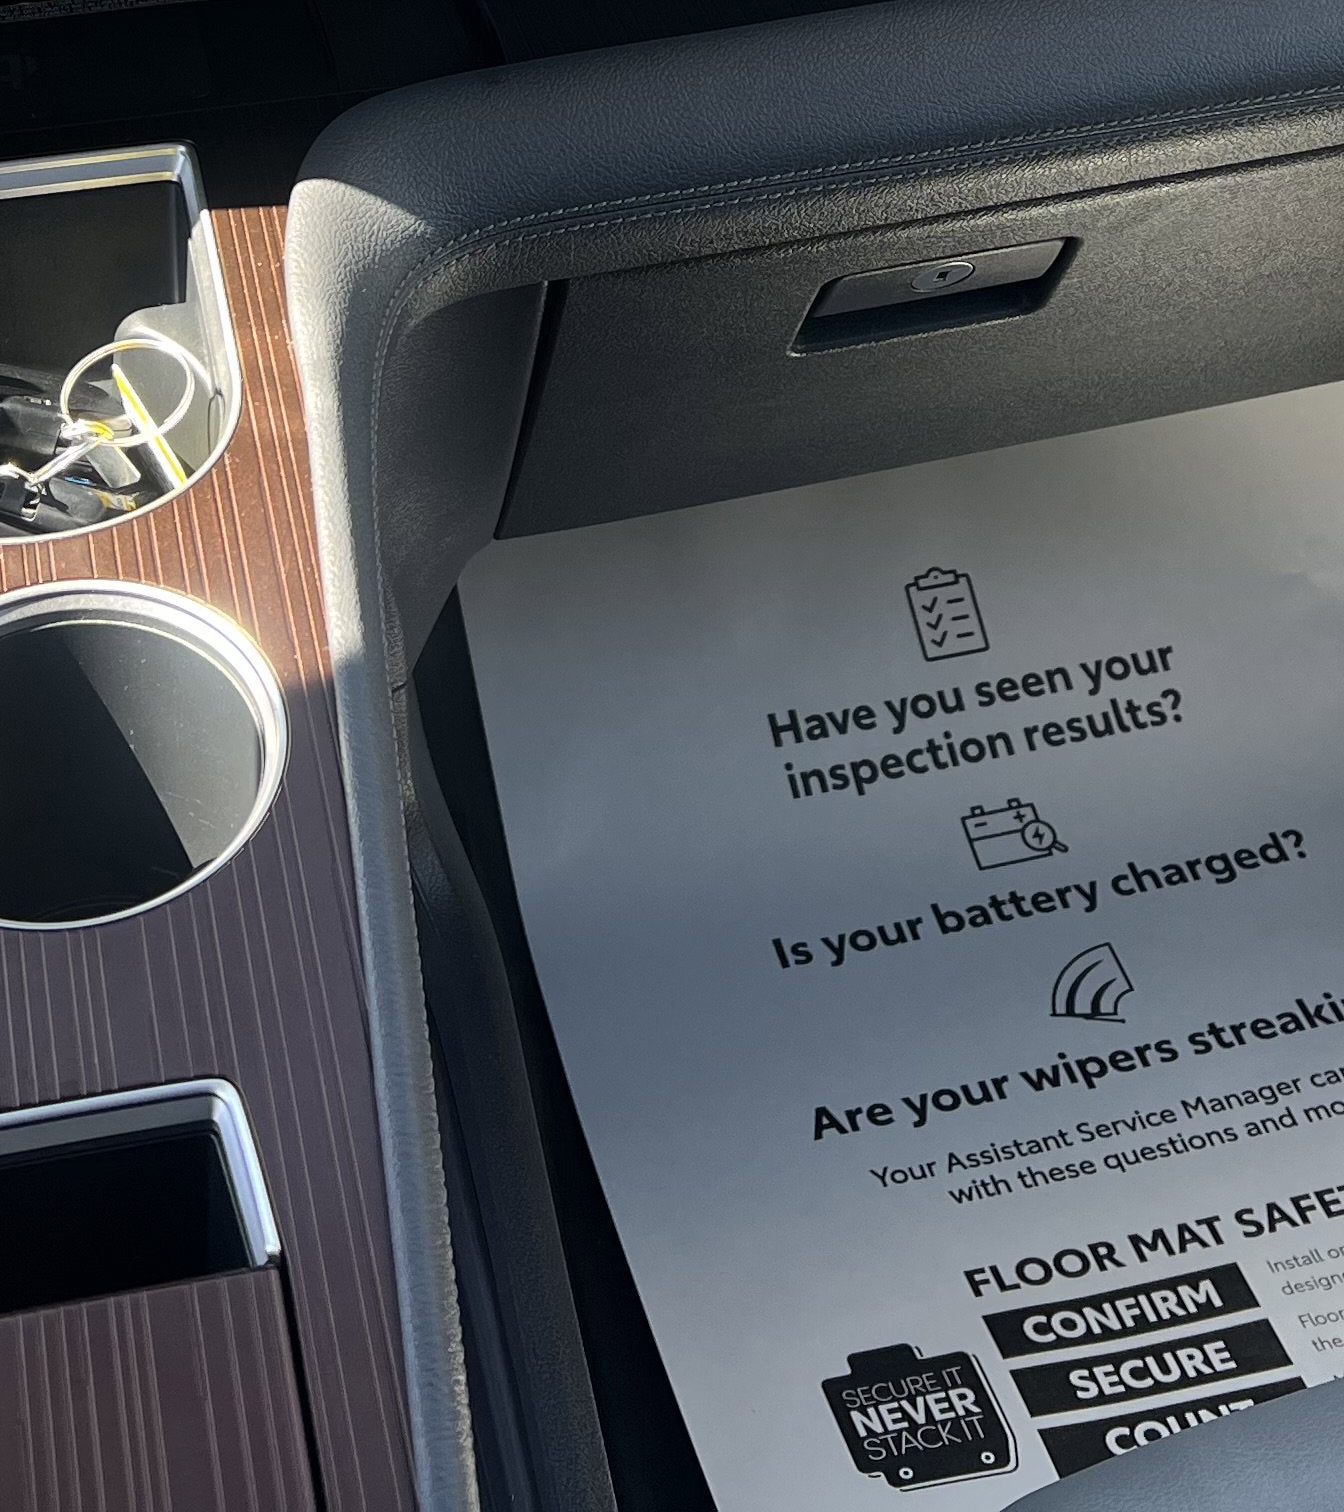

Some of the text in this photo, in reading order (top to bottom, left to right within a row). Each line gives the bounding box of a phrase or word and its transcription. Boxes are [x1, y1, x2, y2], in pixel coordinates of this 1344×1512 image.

[767, 646, 1173, 747] Have you seen your
[787, 688, 1181, 799] inspection results?
[772, 829, 1307, 969] Is your battery charged?
[814, 1103, 895, 1141] Are
[901, 1075, 1009, 1128] your
[1019, 1040, 1179, 1091] wipers
[869, 1161, 936, 1187] Your
[948, 1129, 1074, 1174] Assistant
[1076, 1109, 1177, 1142] Service
[1180, 1078, 1301, 1119] Manager
[948, 1175, 1013, 1204] with
[1017, 1160, 1097, 1189] these
[1103, 1127, 1238, 1173] questions
[1244, 1106, 1298, 1137] and
[963, 1241, 1123, 1297] FLOOR
[1127, 1215, 1224, 1263] MAT
[1266, 1248, 1324, 1273] Install
[1022, 1278, 1224, 1343] CONFIRM
[1297, 1308, 1344, 1330] Floor
[1068, 1340, 1238, 1400] SECURE
[1311, 1335, 1344, 1353] the
[842, 1366, 962, 1409] SECURE IT
[849, 1387, 982, 1438] NEVER
[862, 1414, 986, 1461] STACK IT
